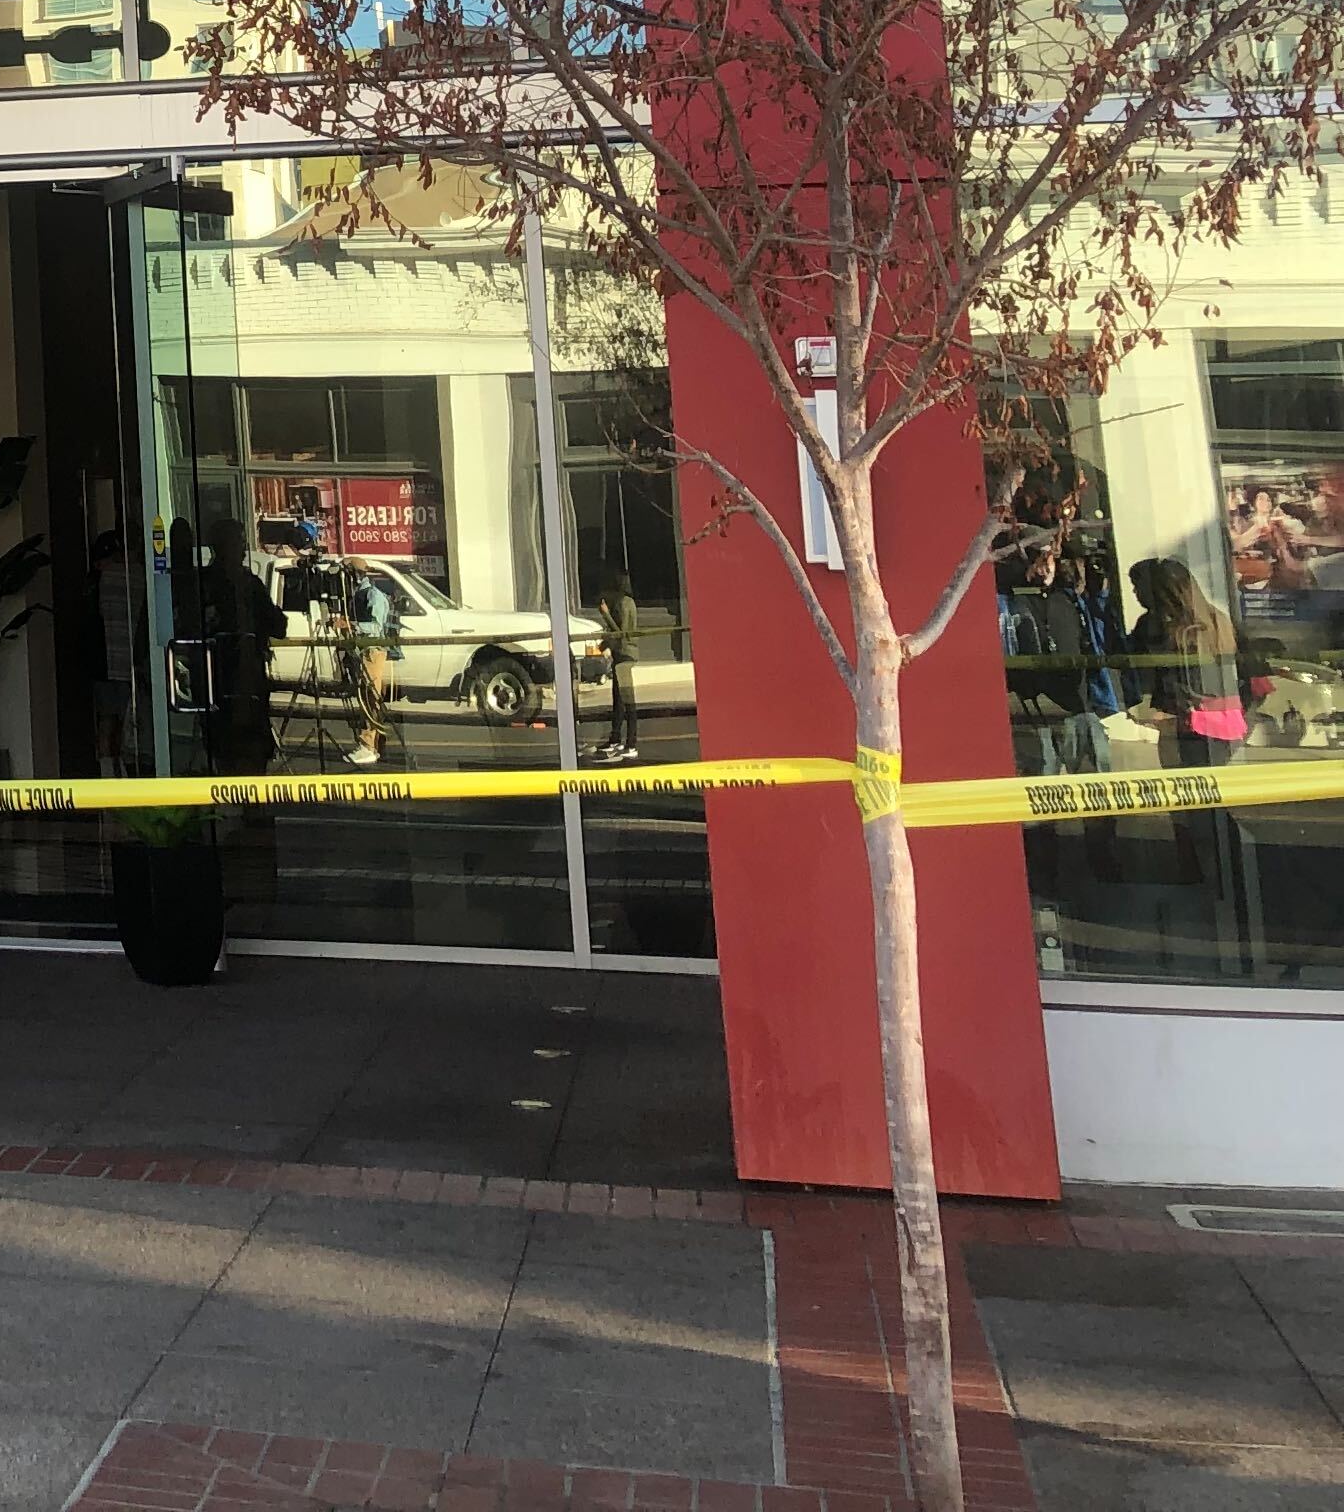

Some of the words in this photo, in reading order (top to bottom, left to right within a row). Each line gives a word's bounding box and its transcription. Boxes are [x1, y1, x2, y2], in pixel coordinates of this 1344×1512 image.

[24, 788, 75, 811] POLICE
[1025, 784, 1078, 815] CROSS
[1077, 782, 1112, 812] NOT
[1109, 781, 1135, 811] DO
[1131, 778, 1170, 809] LINE
[1167, 776, 1222, 806] POLICE
